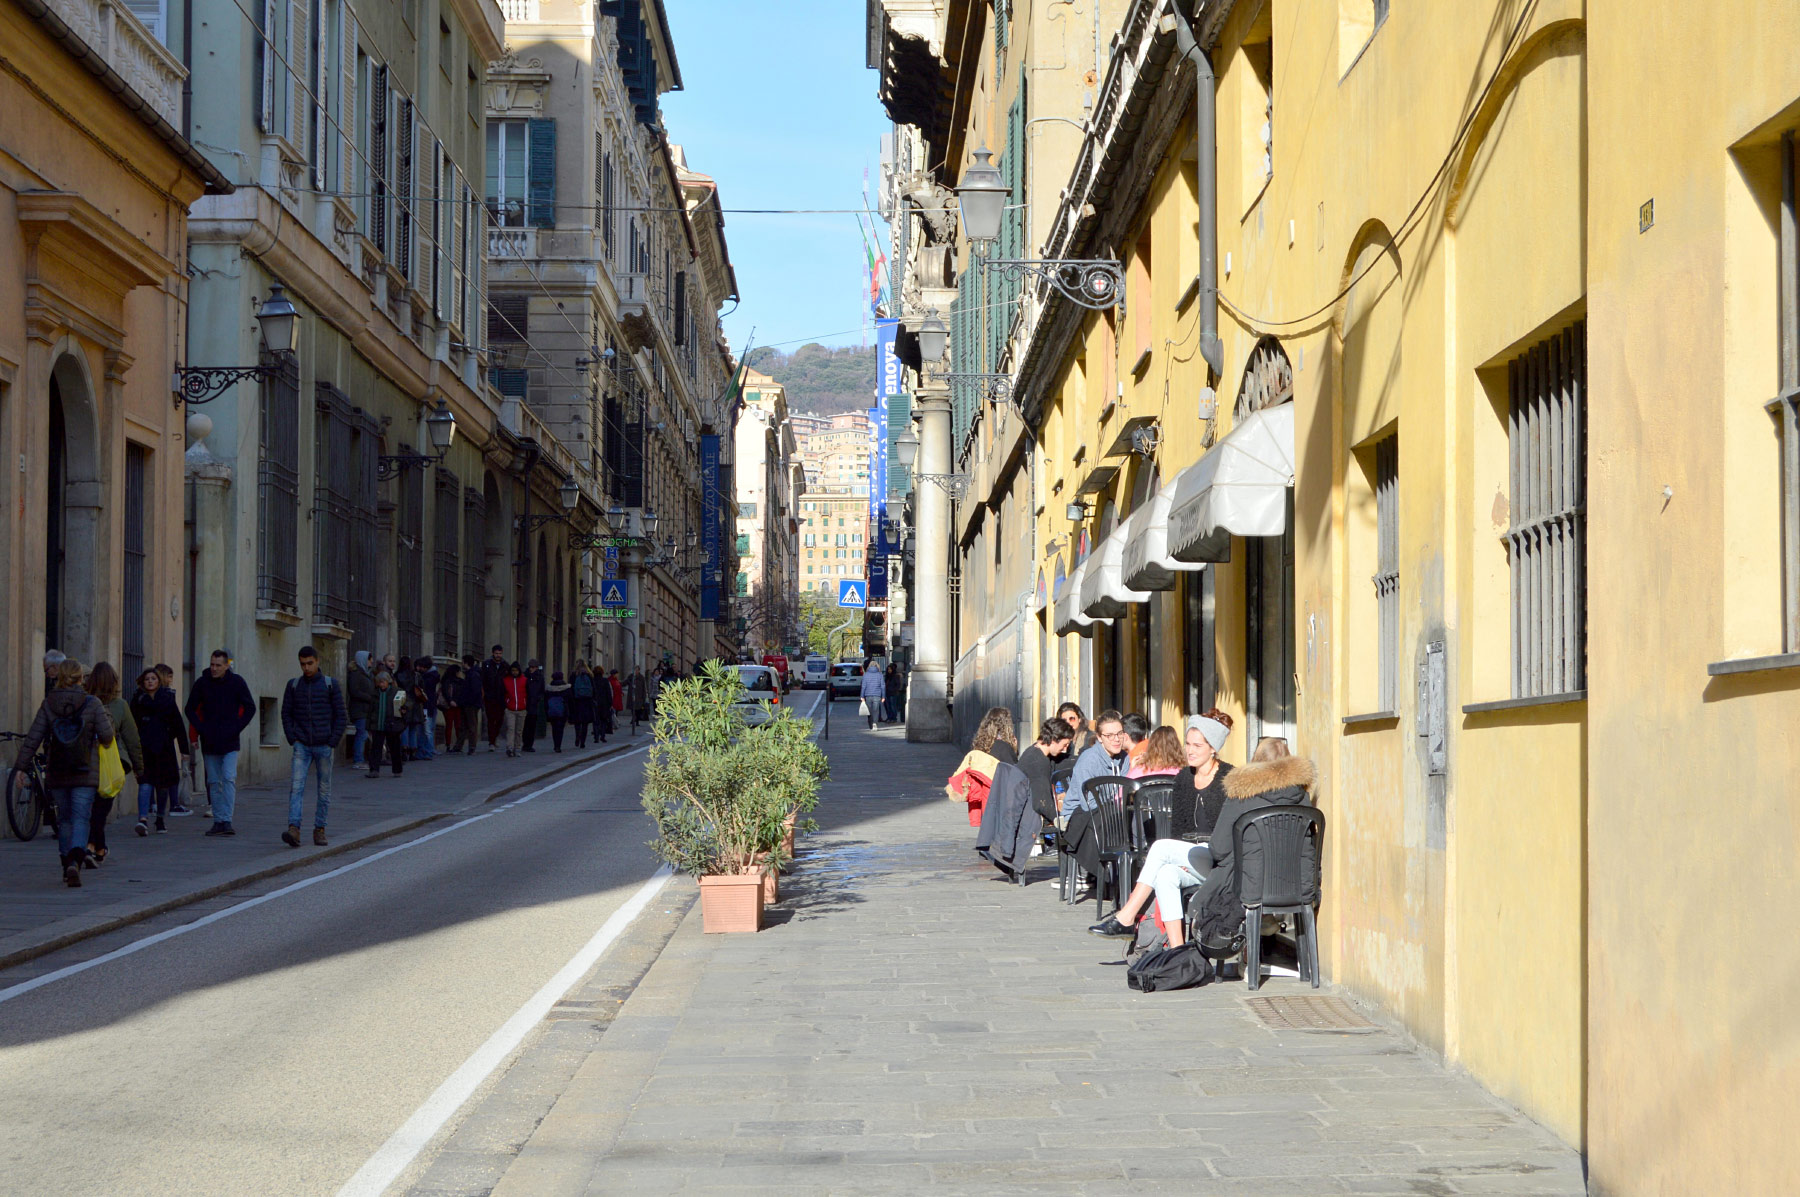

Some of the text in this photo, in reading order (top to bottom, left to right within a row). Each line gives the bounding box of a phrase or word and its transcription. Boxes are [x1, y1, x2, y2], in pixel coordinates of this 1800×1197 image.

[704, 452, 716, 581] MUSEO PALAZZO REALE
